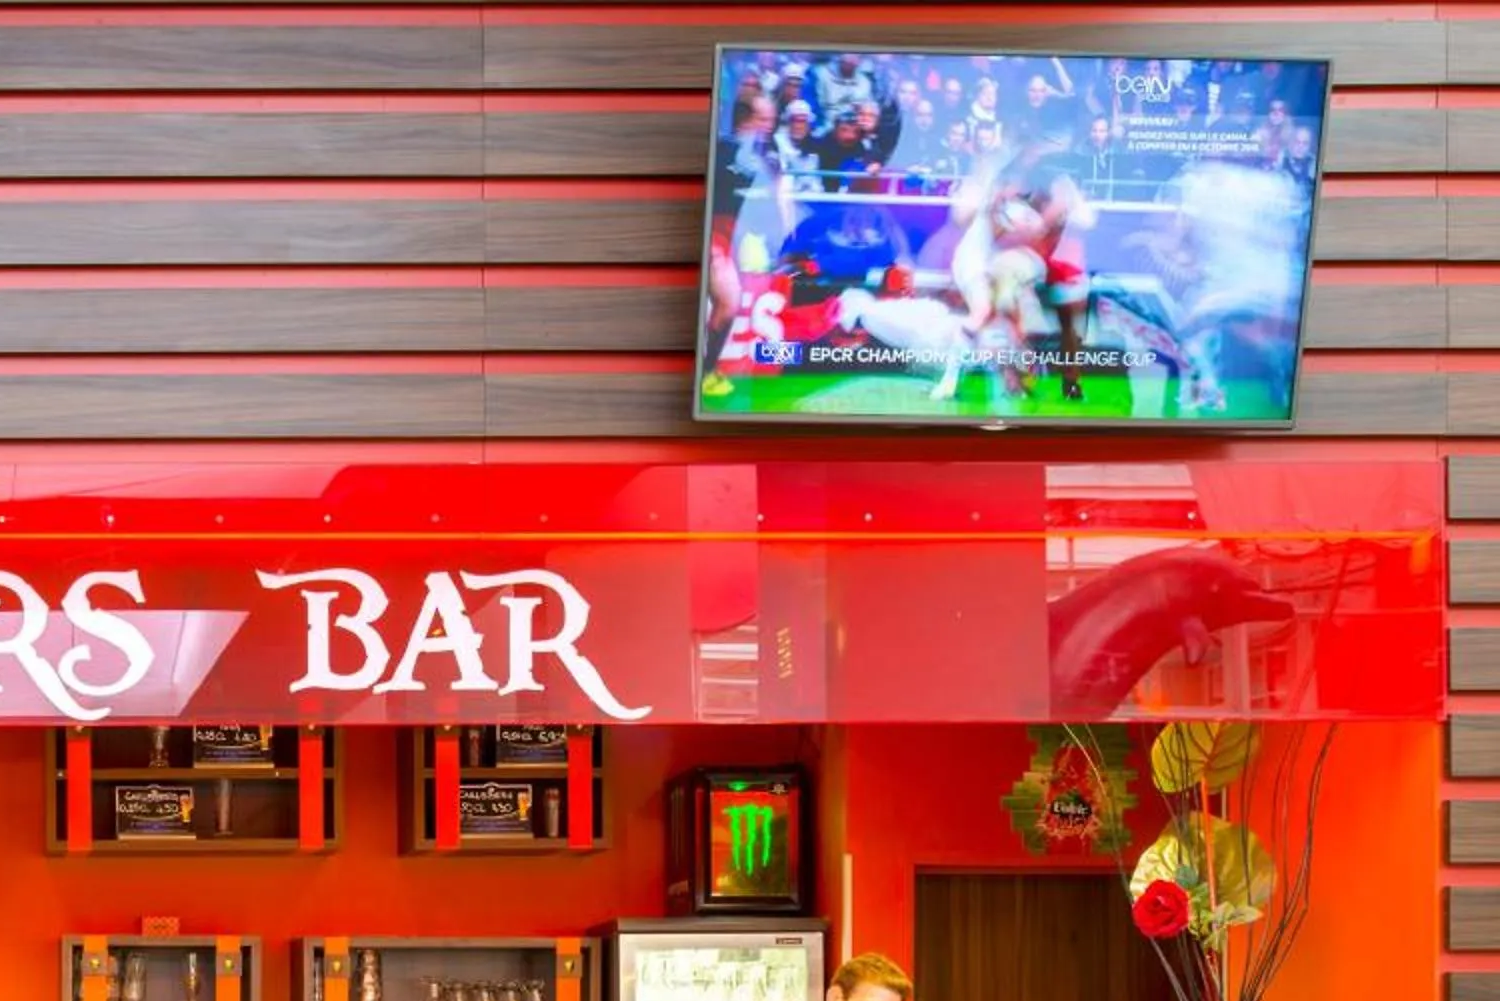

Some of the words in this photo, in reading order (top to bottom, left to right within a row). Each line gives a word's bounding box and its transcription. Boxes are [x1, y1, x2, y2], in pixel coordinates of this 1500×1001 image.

[809, 347, 853, 363] EPCR
[960, 350, 992, 365] CUP
[1021, 350, 1119, 367] CHALLENGE
[1122, 351, 1157, 367] CUP
[255, 569, 652, 721] BAR
